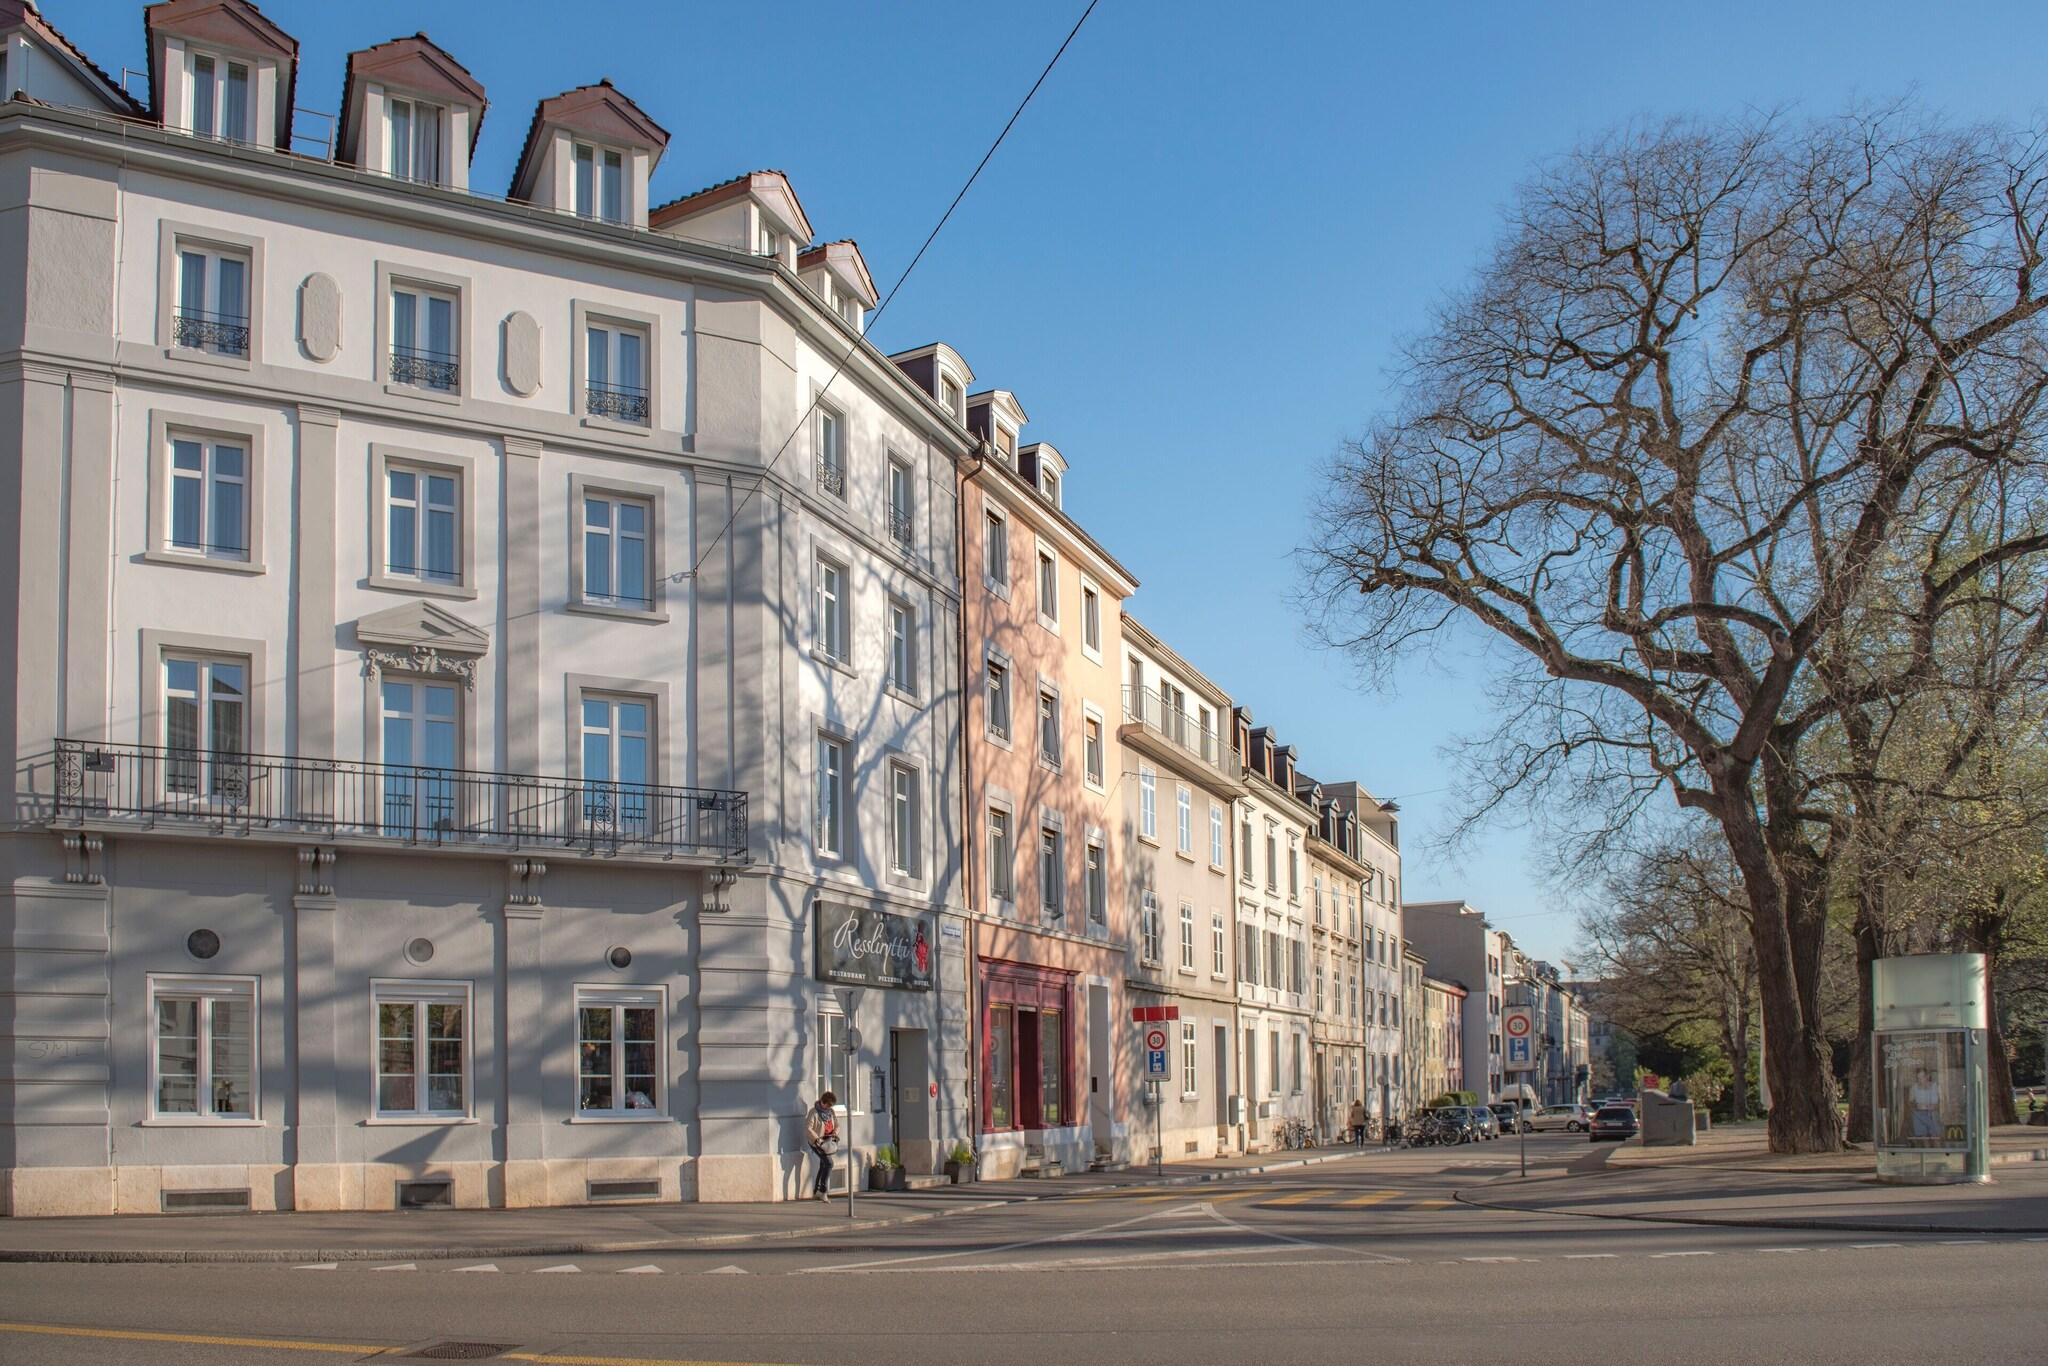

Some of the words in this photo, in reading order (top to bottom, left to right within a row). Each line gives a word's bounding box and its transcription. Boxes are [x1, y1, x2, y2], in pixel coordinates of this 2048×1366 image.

[829, 970, 865, 980] RESTAURANT
[1513, 1022, 1522, 1030] 30
[1152, 1036, 1160, 1045] 30
[1515, 1039, 1523, 1050] P
[1154, 1052, 1160, 1062] P
